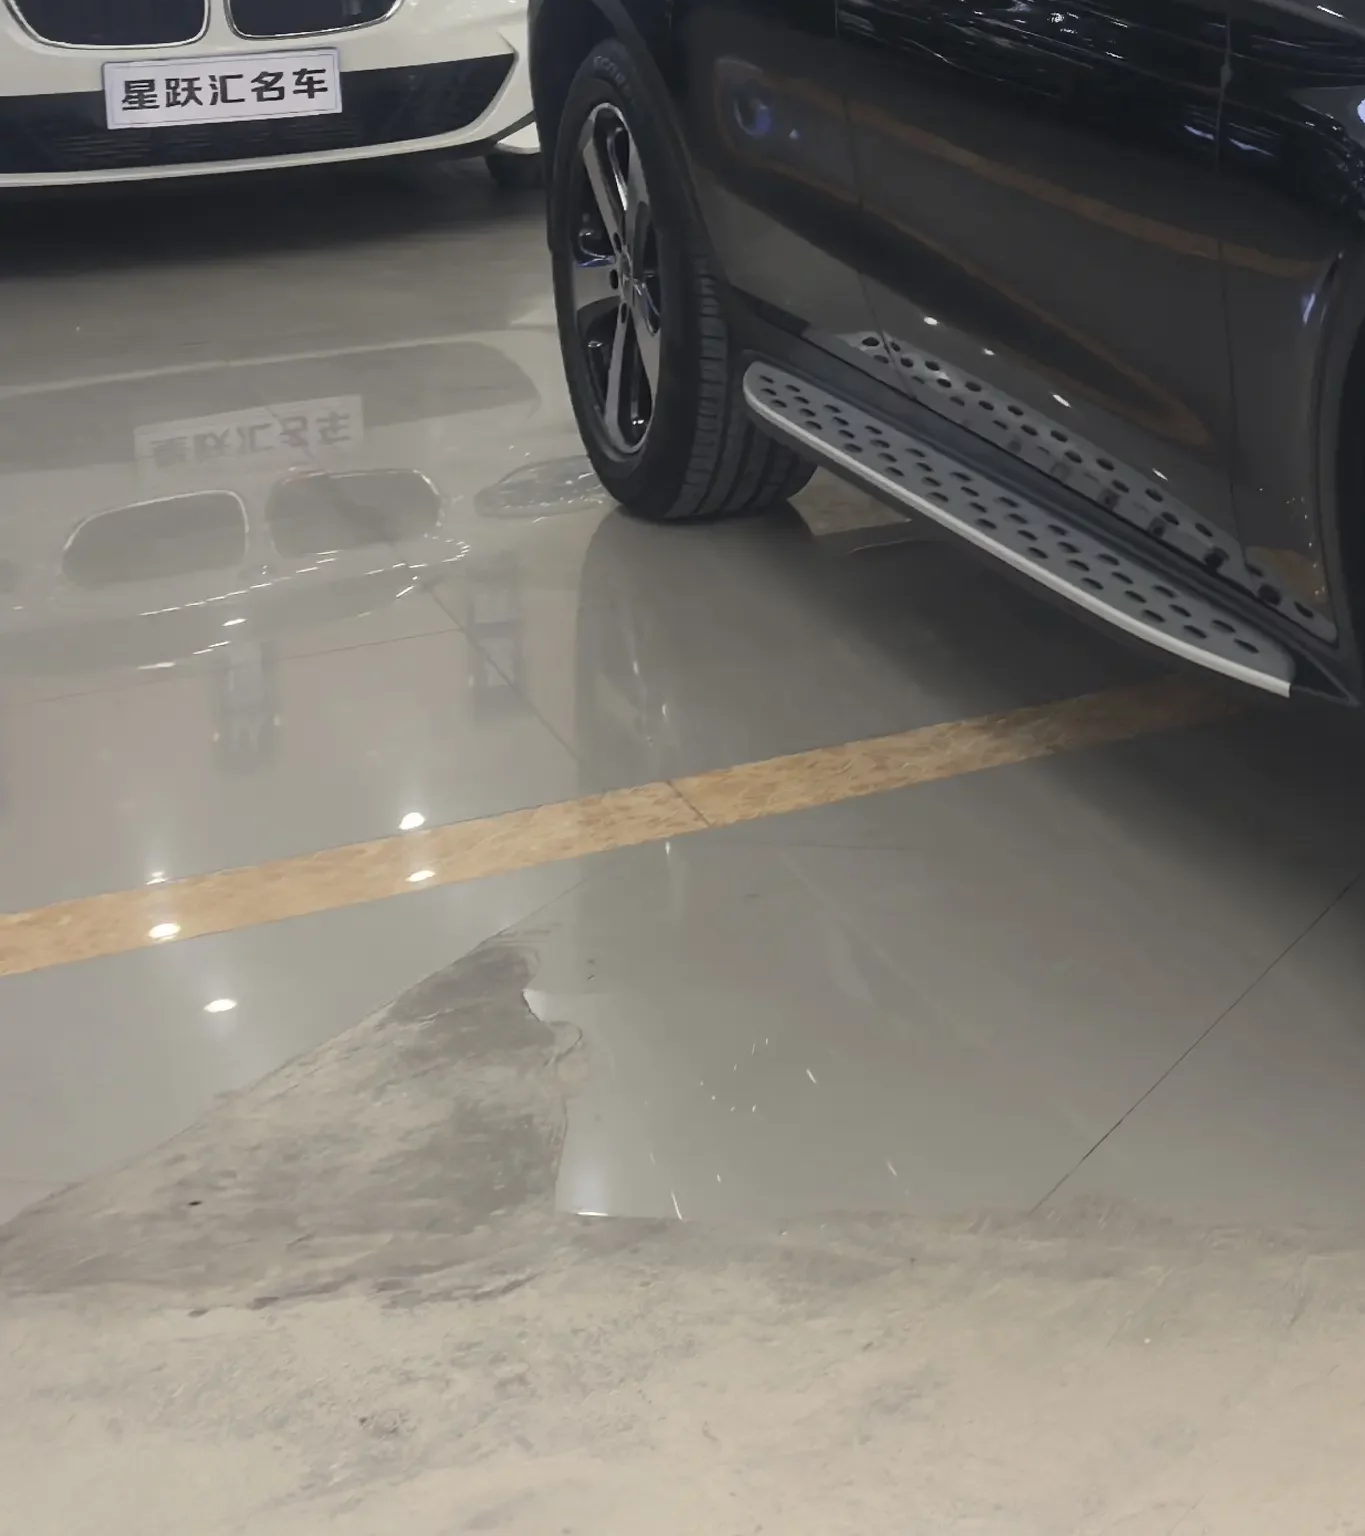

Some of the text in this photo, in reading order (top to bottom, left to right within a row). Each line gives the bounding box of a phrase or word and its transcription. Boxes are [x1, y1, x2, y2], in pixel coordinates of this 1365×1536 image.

[122, 68, 329, 111] 星跃汇名车
